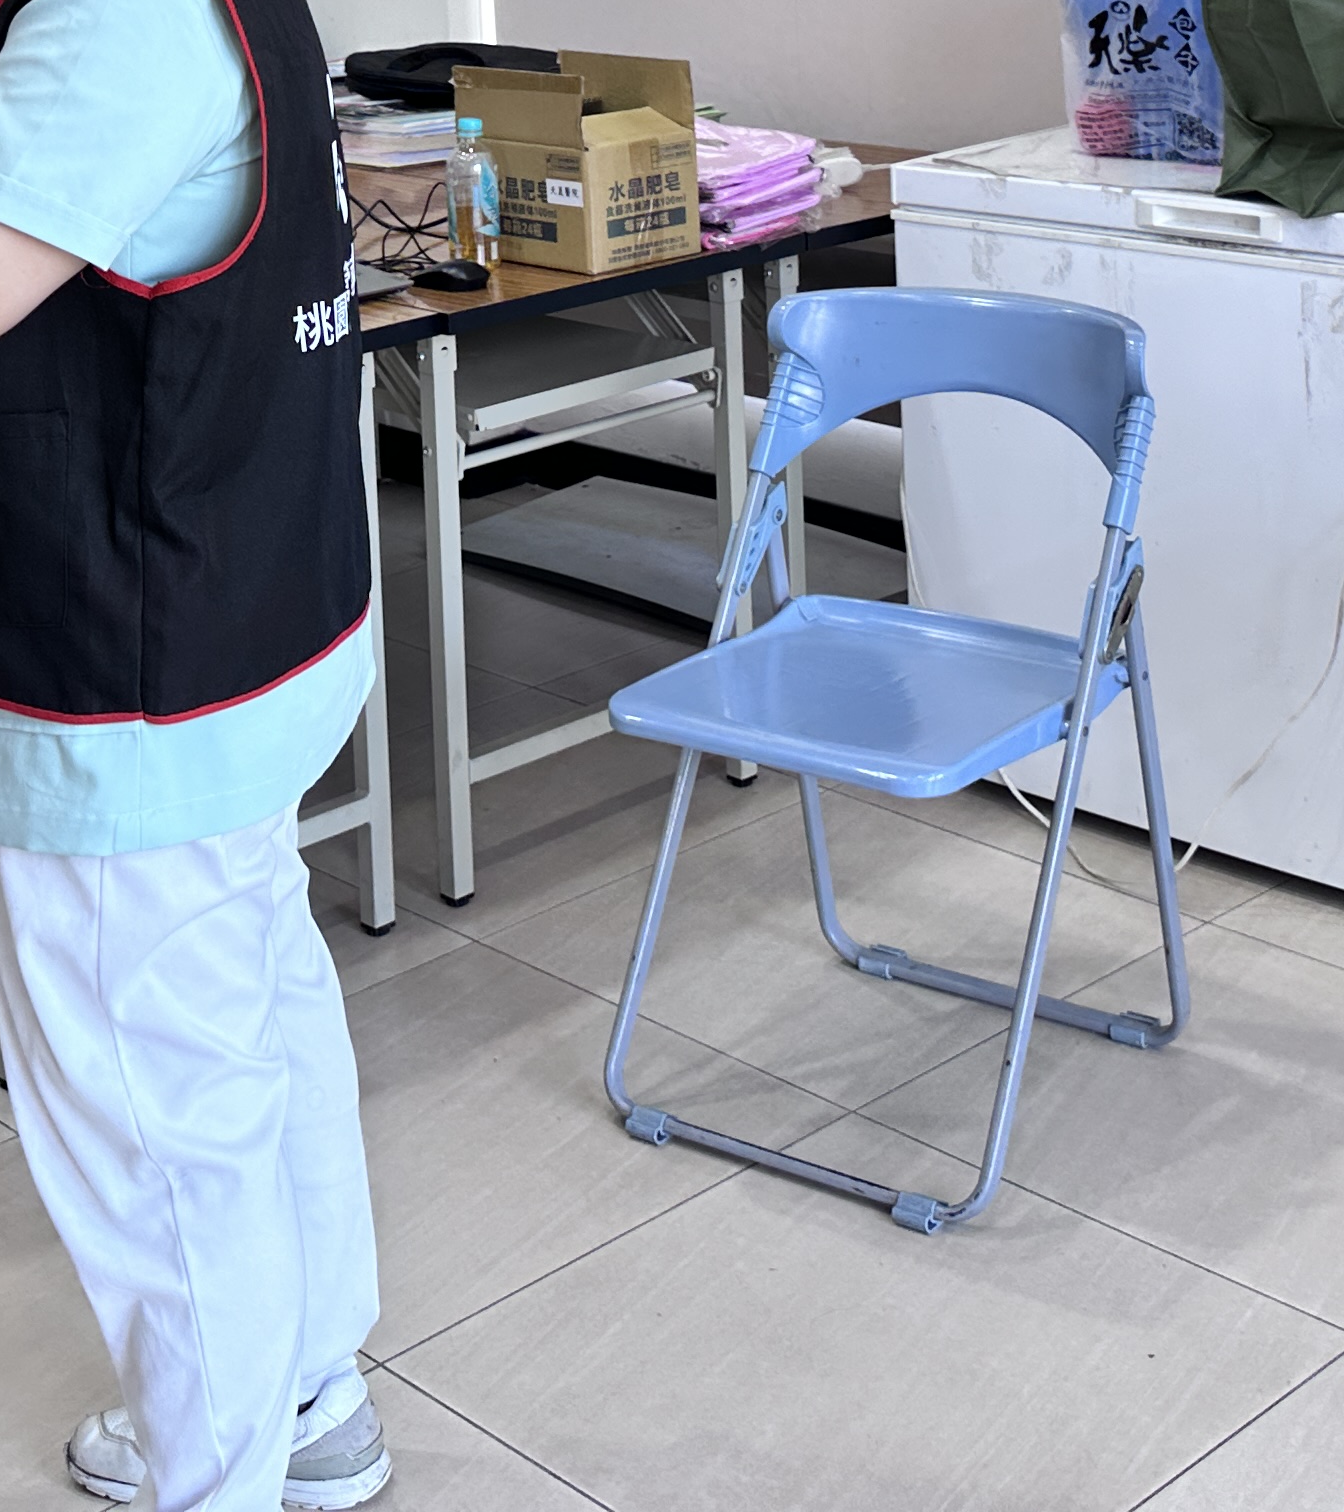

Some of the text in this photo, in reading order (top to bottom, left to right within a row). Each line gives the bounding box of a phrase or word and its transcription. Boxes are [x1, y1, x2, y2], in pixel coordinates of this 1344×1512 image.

[1173, 12, 1200, 75] 包子
[608, 171, 681, 203] 水晶肥皂
